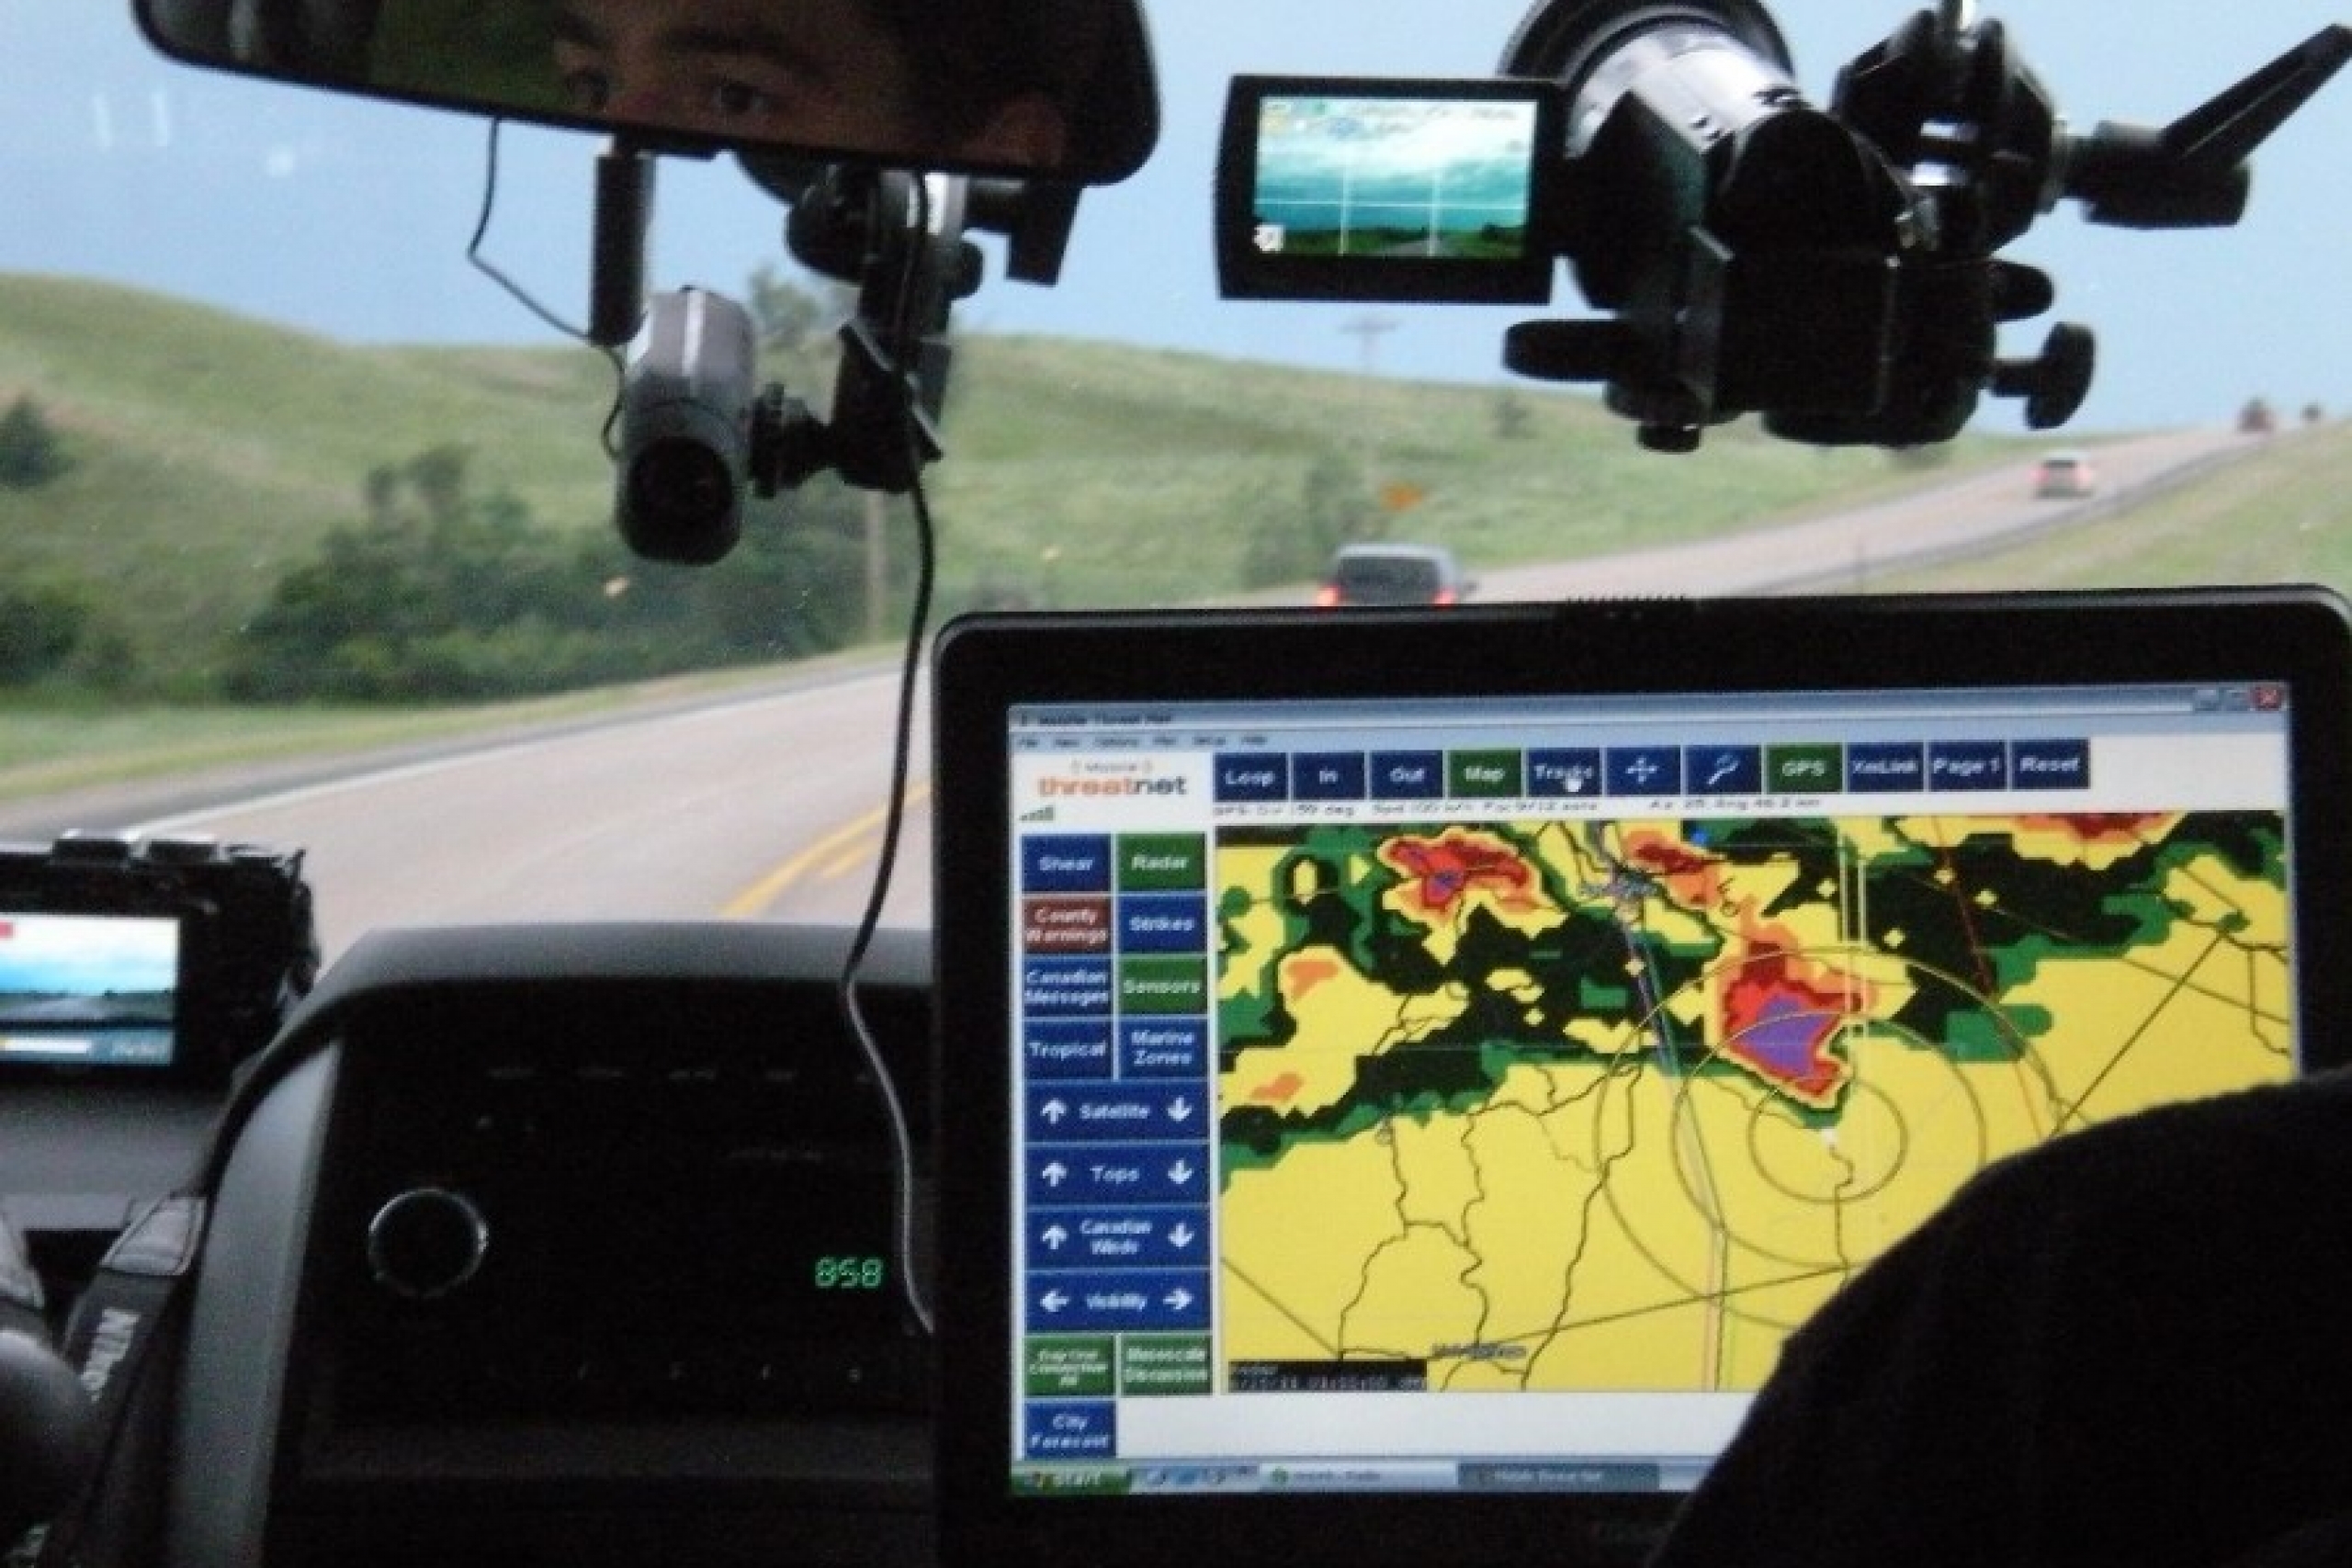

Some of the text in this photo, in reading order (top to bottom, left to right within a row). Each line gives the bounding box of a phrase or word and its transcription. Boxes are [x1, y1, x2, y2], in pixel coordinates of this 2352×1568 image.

[1464, 764, 1506, 784] Map
[1781, 759, 1826, 777] GPS
[1932, 757, 2000, 777] Page 1
[2019, 757, 2081, 773] Reset
[1224, 769, 1275, 788] Loop
[1317, 768, 1339, 784] In
[1388, 765, 1425, 784] Out
[1038, 776, 1187, 796] threatnet
[1038, 854, 1096, 871] Shear
[1131, 853, 1190, 871] Radar
[1034, 906, 1098, 926] County
[1129, 917, 1194, 932] Strikes
[1026, 928, 1108, 945] Warnings
[1025, 968, 1109, 985] Canadian
[1123, 979, 1202, 994] Sensors
[1023, 987, 1109, 1007] Messages
[1130, 1029, 1194, 1045] Marine
[1027, 1040, 1107, 1062] Tropical
[1133, 1049, 1193, 1066] Zones
[1079, 1103, 1151, 1120] Satellite
[1090, 1165, 1140, 1185] Tops
[1053, 1413, 1091, 1431] City
[1030, 1433, 1109, 1449] Forecast
